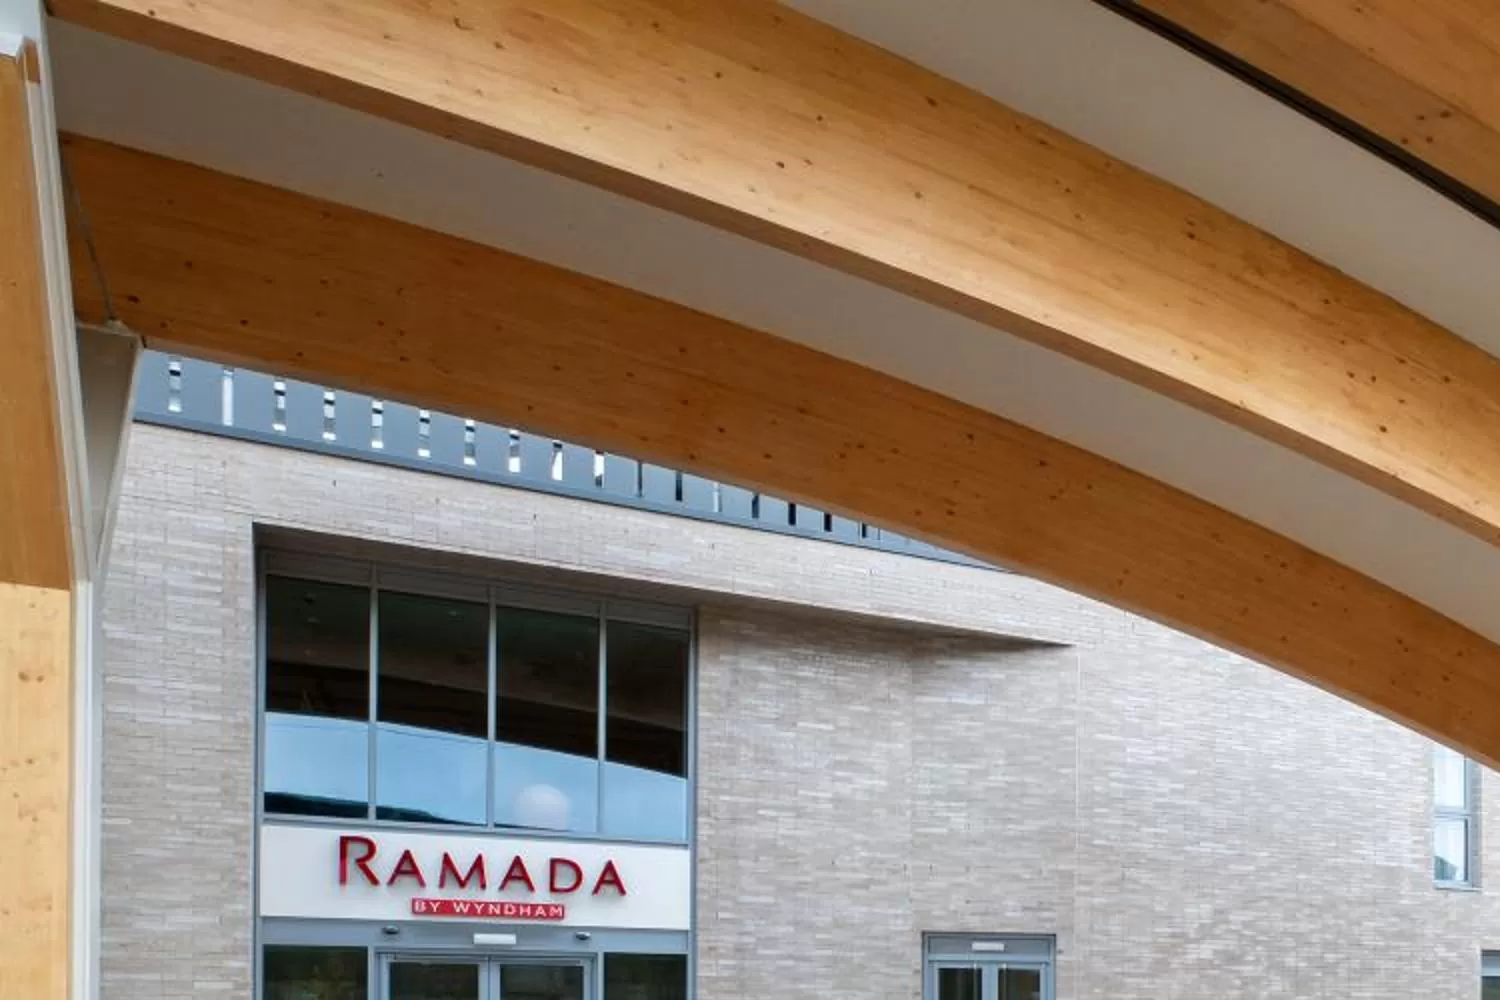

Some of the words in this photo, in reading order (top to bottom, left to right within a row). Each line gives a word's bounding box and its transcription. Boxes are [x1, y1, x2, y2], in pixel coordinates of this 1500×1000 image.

[339, 836, 626, 896] RAMADA
[415, 902, 442, 913] BY
[454, 903, 563, 918] WYNDHAM
